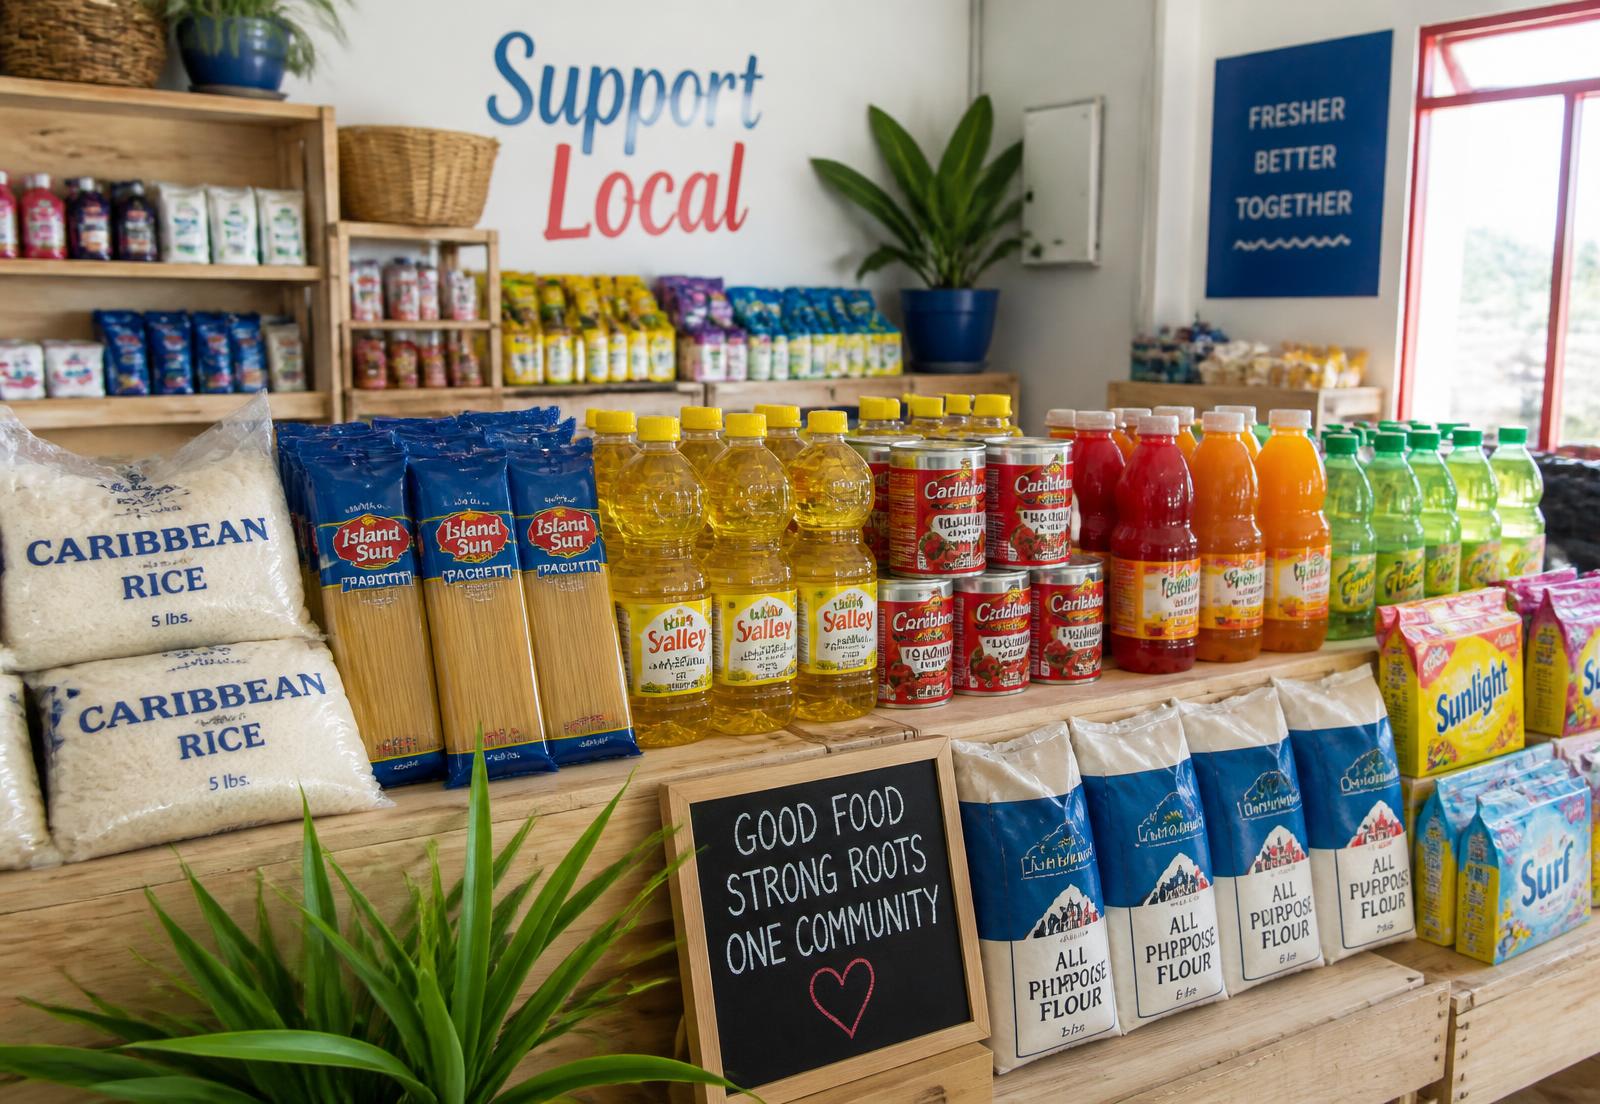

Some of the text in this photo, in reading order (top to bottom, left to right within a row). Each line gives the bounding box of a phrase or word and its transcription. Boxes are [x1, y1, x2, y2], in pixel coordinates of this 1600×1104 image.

[487, 31, 763, 155] Support
[1249, 97, 1346, 130] FRESHER
[1254, 144, 1337, 175] BETTER
[543, 142, 749, 241] Local
[1235, 190, 1353, 221] TOGETHER
[342, 525, 401, 548] Island
[444, 518, 502, 543] Island
[536, 515, 590, 537] Island
[26, 517, 270, 567] CARIBBEAN
[356, 544, 394, 562] Sun
[457, 538, 493, 556] Sun
[550, 533, 584, 551] Sun
[122, 567, 207, 600] RICE
[151, 611, 193, 627] 5 lbs.
[78, 672, 327, 734] CARIBBEAN
[1437, 659, 1508, 733] Sunlight
[177, 722, 266, 760] RICE
[209, 774, 250, 791] 5 lbs.
[734, 786, 904, 856] GOOD FOOD
[727, 834, 927, 916] STRONG ROOTS
[1372, 854, 1395, 875] ALL
[1521, 840, 1574, 907] Surf
[1272, 881, 1296, 902] ALL
[726, 884, 938, 975] ONE COMMUNITY
[1170, 912, 1198, 935] ALL
[1262, 919, 1310, 949] FLOUR
[1055, 946, 1088, 972] ALL
[1157, 952, 1211, 985] FLOUR
[1040, 986, 1102, 1021] FLOUR
